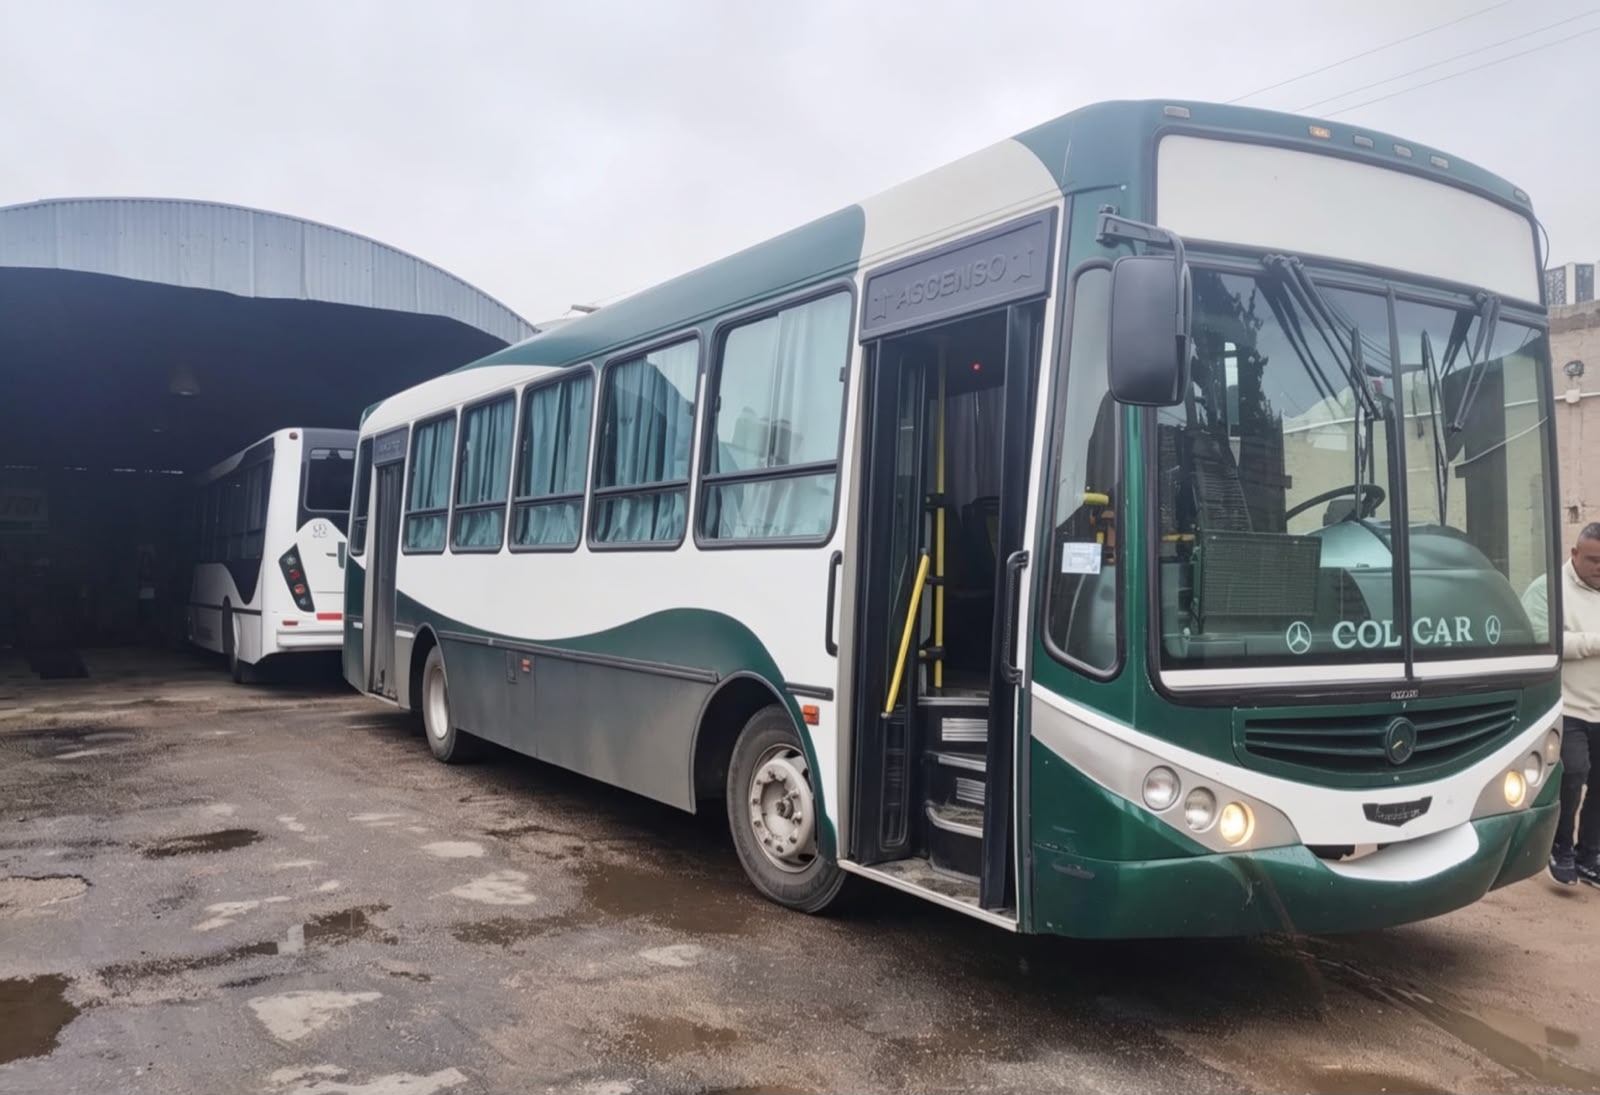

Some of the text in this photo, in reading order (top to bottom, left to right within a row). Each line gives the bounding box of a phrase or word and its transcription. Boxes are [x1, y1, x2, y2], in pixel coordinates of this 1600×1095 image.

[896, 254, 1007, 309] ASCENSO
[1332, 616, 1473, 649] COL CAR
